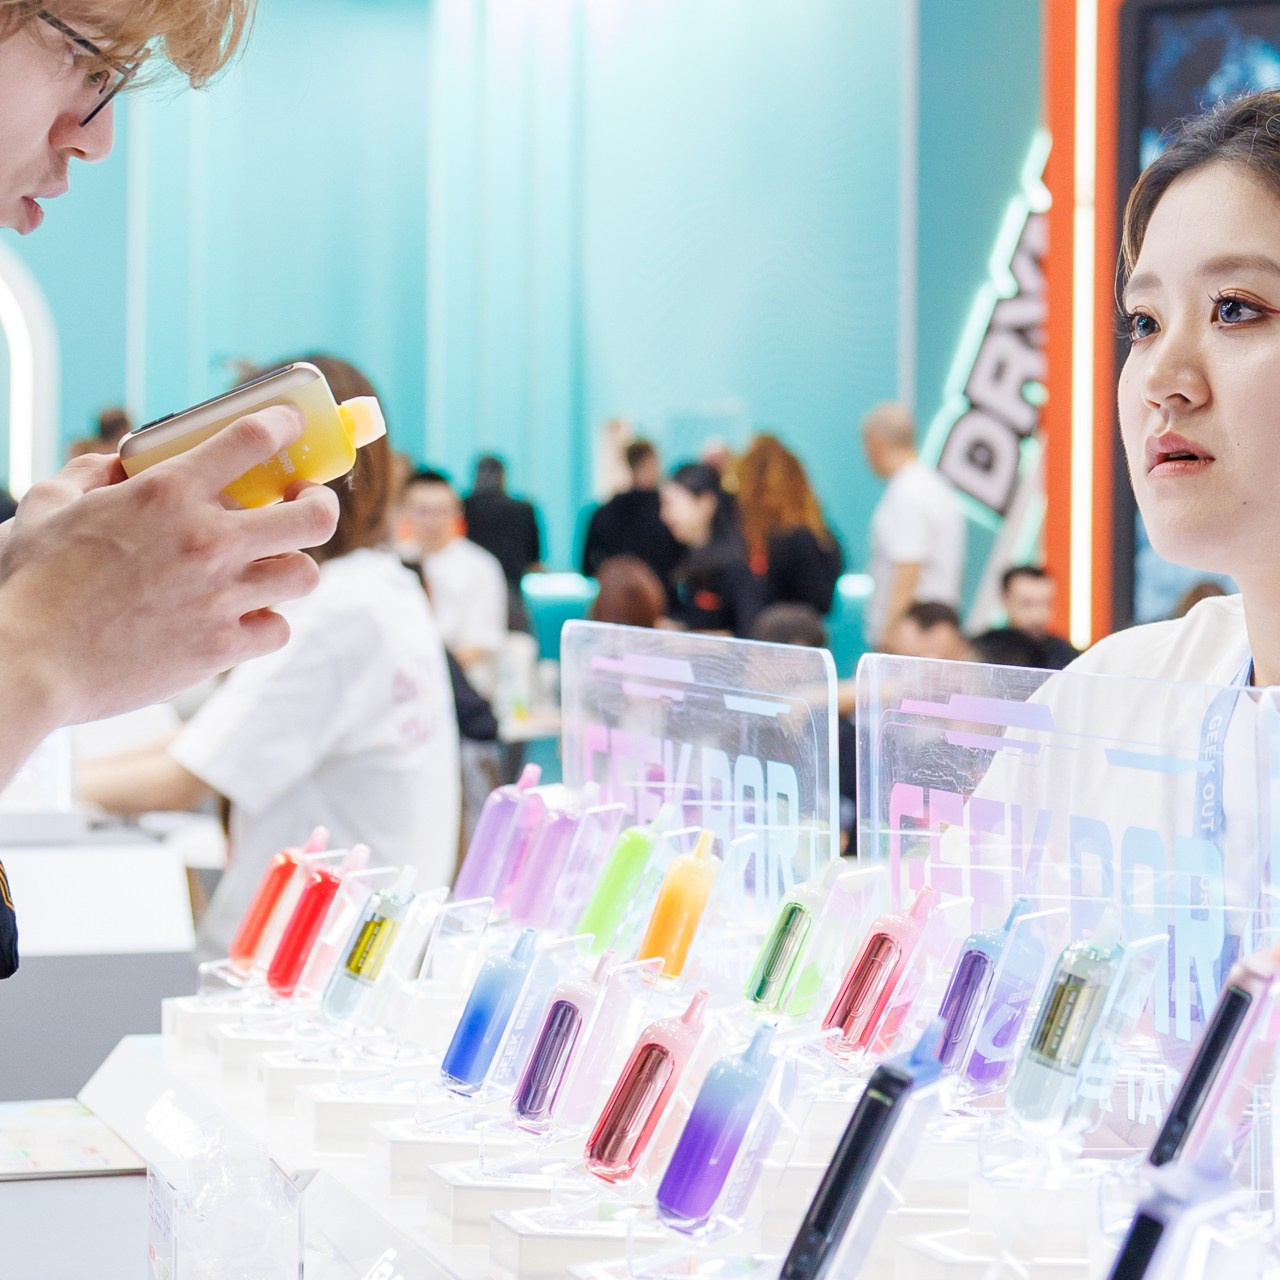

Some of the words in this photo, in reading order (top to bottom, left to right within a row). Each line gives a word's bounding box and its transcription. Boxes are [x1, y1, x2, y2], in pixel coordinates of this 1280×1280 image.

[700, 746, 800, 913] BAR
[1200, 782, 1217, 832] OUT
[1069, 814, 1227, 1042] BAR
